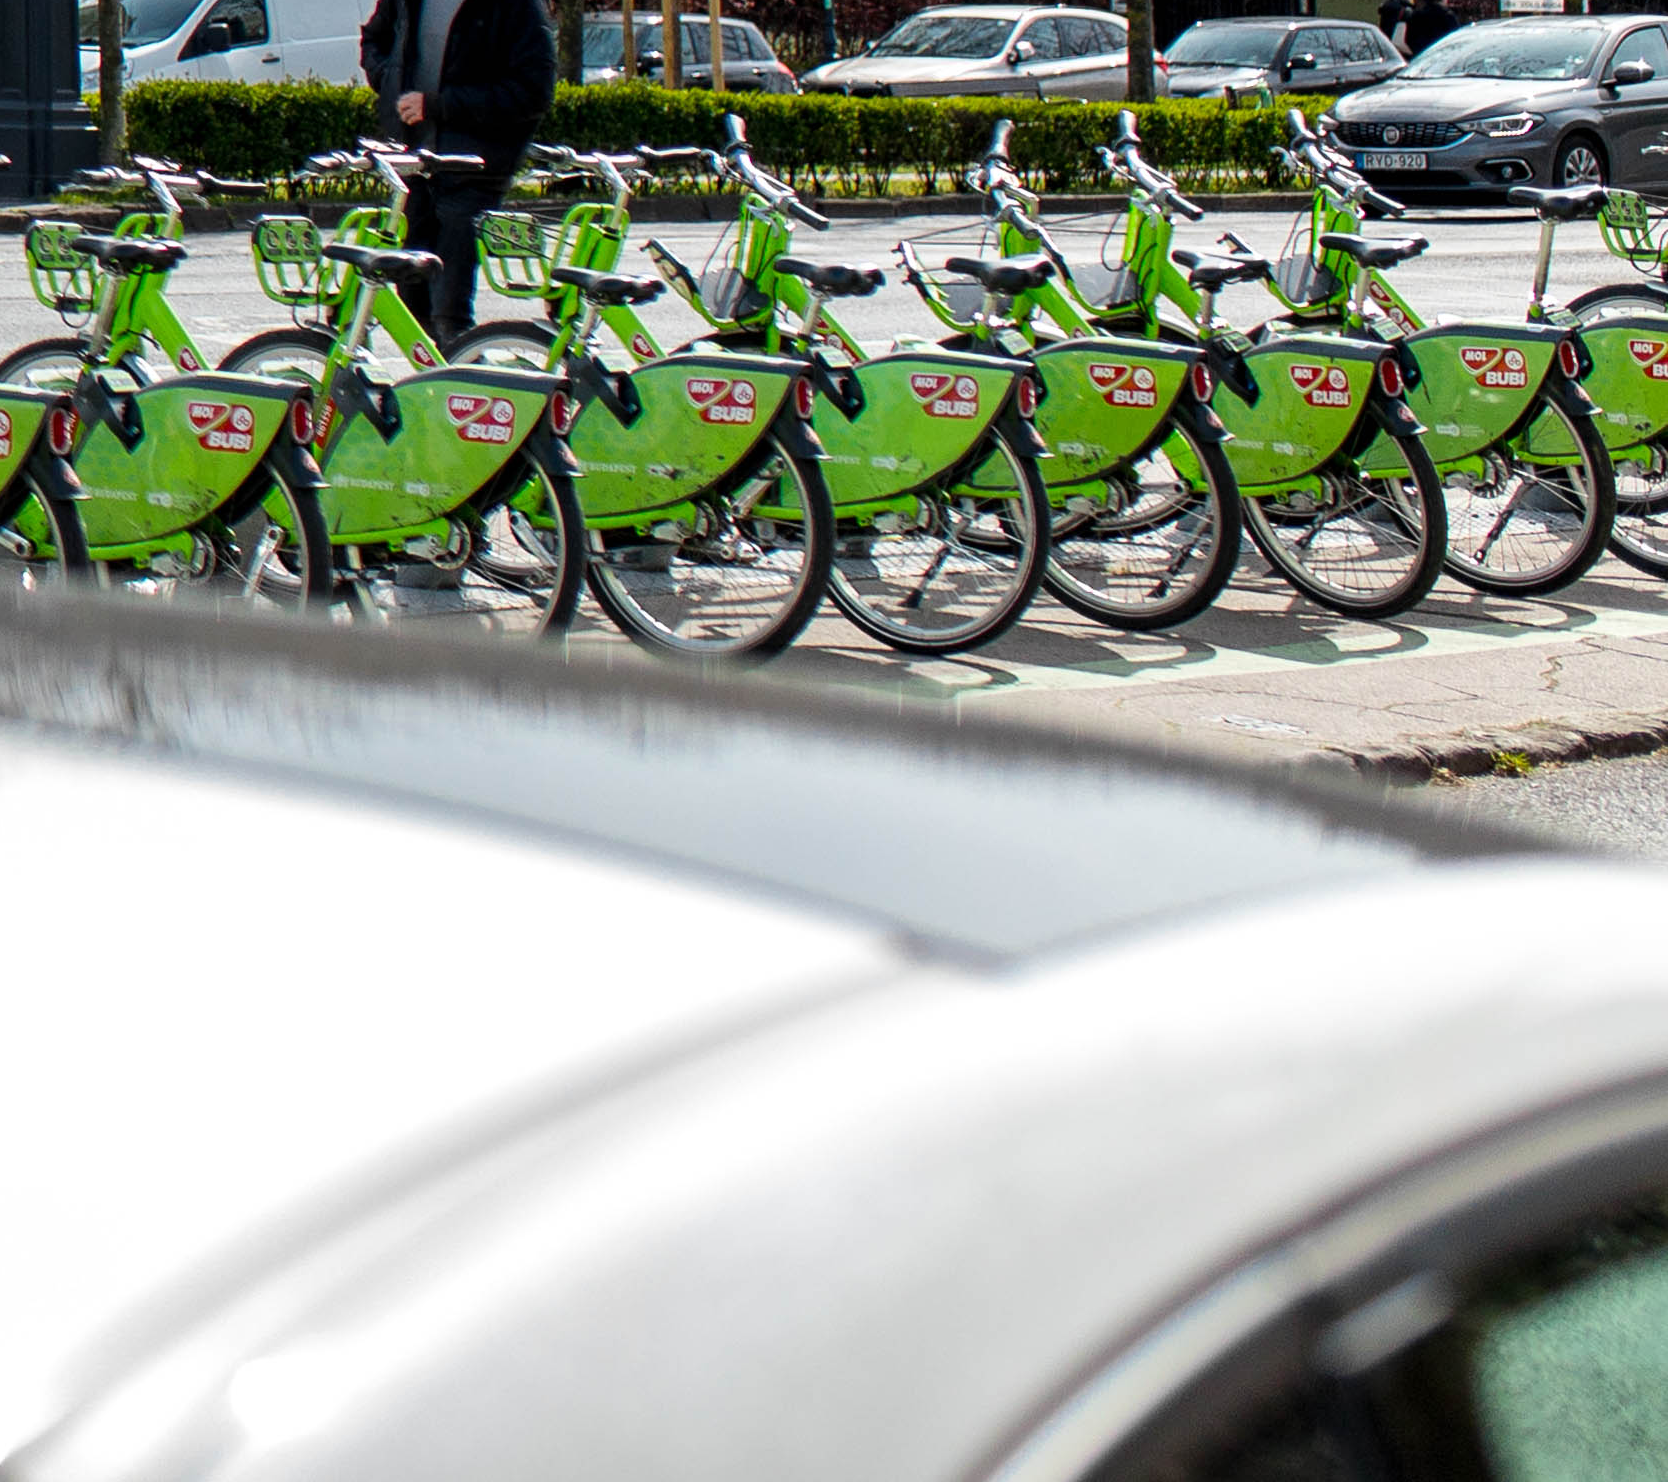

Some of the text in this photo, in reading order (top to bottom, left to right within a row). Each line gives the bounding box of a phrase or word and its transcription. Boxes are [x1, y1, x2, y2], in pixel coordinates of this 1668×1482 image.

[1365, 155, 1423, 167] RYD-920
[1464, 349, 1489, 362] MOL
[1633, 342, 1655, 354] MOL
[1092, 366, 1117, 380] MOL
[1485, 371, 1526, 387] BUBI
[914, 375, 939, 389] MOL
[1112, 389, 1156, 406] BUBI
[708, 404, 754, 424] BUBI
[932, 398, 978, 417] BUBI
[206, 429, 253, 451] BUBI
[466, 421, 512, 443] BUBI
